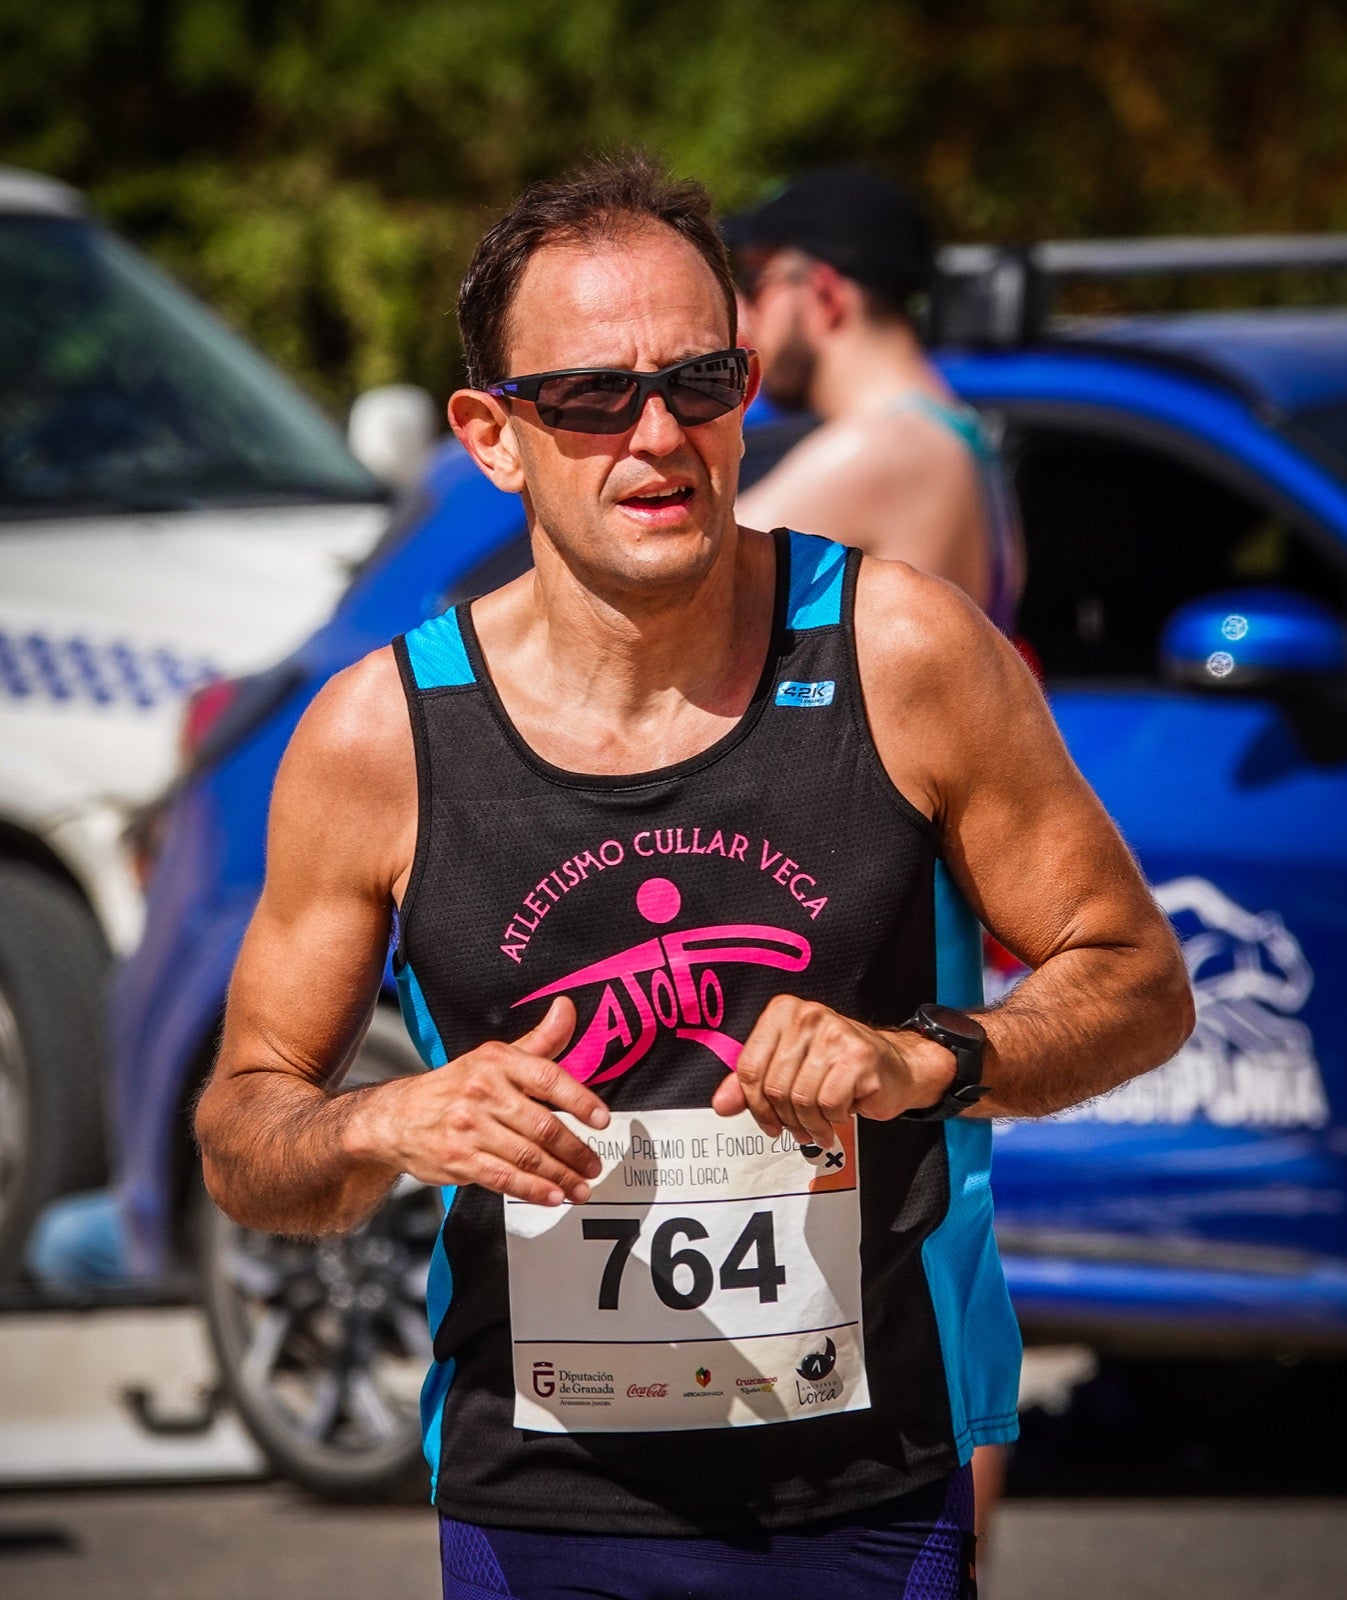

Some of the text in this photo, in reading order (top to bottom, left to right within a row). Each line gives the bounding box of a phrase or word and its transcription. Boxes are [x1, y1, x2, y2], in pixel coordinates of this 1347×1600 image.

[783, 686, 826, 698] 42K
[500, 828, 828, 964] ATLETISMO CULLAR VEGA
[631, 1135, 685, 1160] PREMIO
[692, 1138, 709, 1158] DE
[716, 1133, 764, 1157] FONDO
[623, 1164, 729, 1187] UNIVERSO LORCA
[581, 1210, 786, 1311] 764
[559, 1370, 614, 1383] Diputación
[559, 1383, 615, 1394] de Granada
[796, 1380, 837, 1406] Lorca
